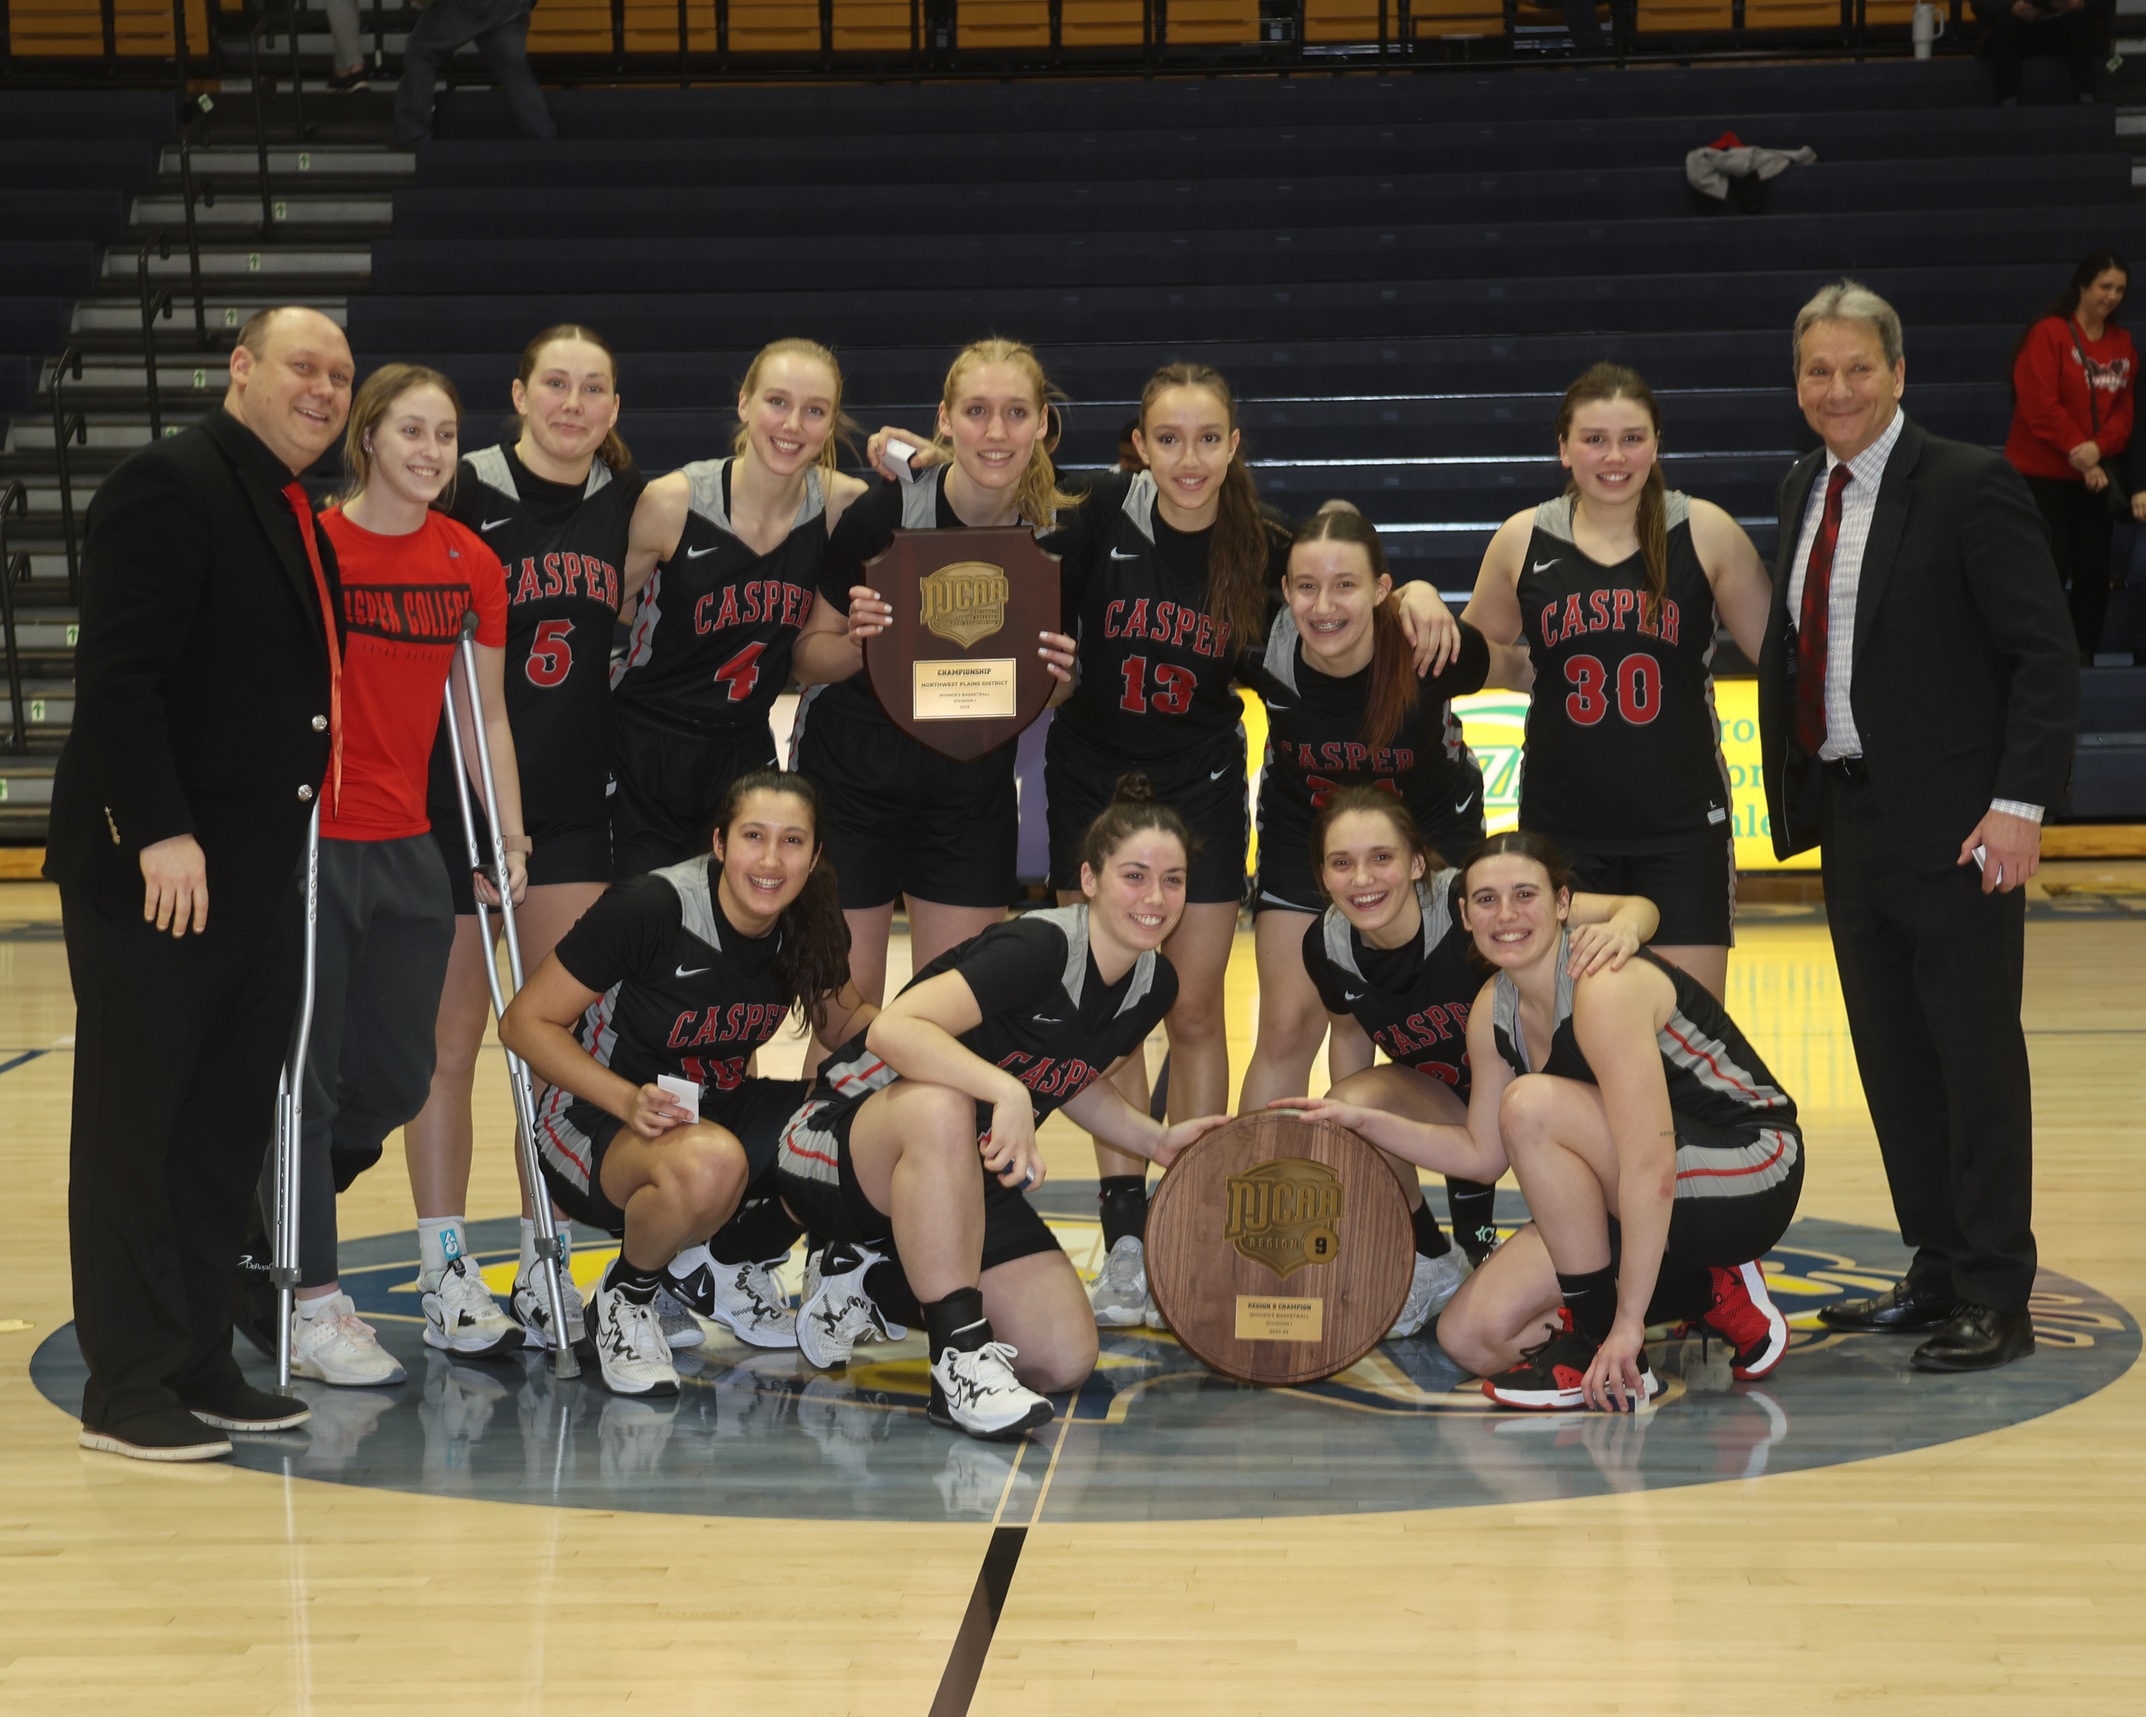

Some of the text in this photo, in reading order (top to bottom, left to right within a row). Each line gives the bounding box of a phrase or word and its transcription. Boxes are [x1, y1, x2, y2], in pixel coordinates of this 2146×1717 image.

[694, 580, 814, 635] CASPER
[923, 578, 1006, 621] NJCAA
[525, 618, 576, 688] 5
[1104, 598, 1231, 658] CASPER
[713, 641, 768, 701] 4
[937, 668, 991, 676] CHAMPIONSHIP
[1120, 653, 1198, 714] 13
[1563, 652, 1663, 726] 30
[1373, 1001, 1473, 1057] CASPE
[1228, 1180, 1339, 1233] NJCAA
[1249, 1237, 1327, 1255] REGION 9
